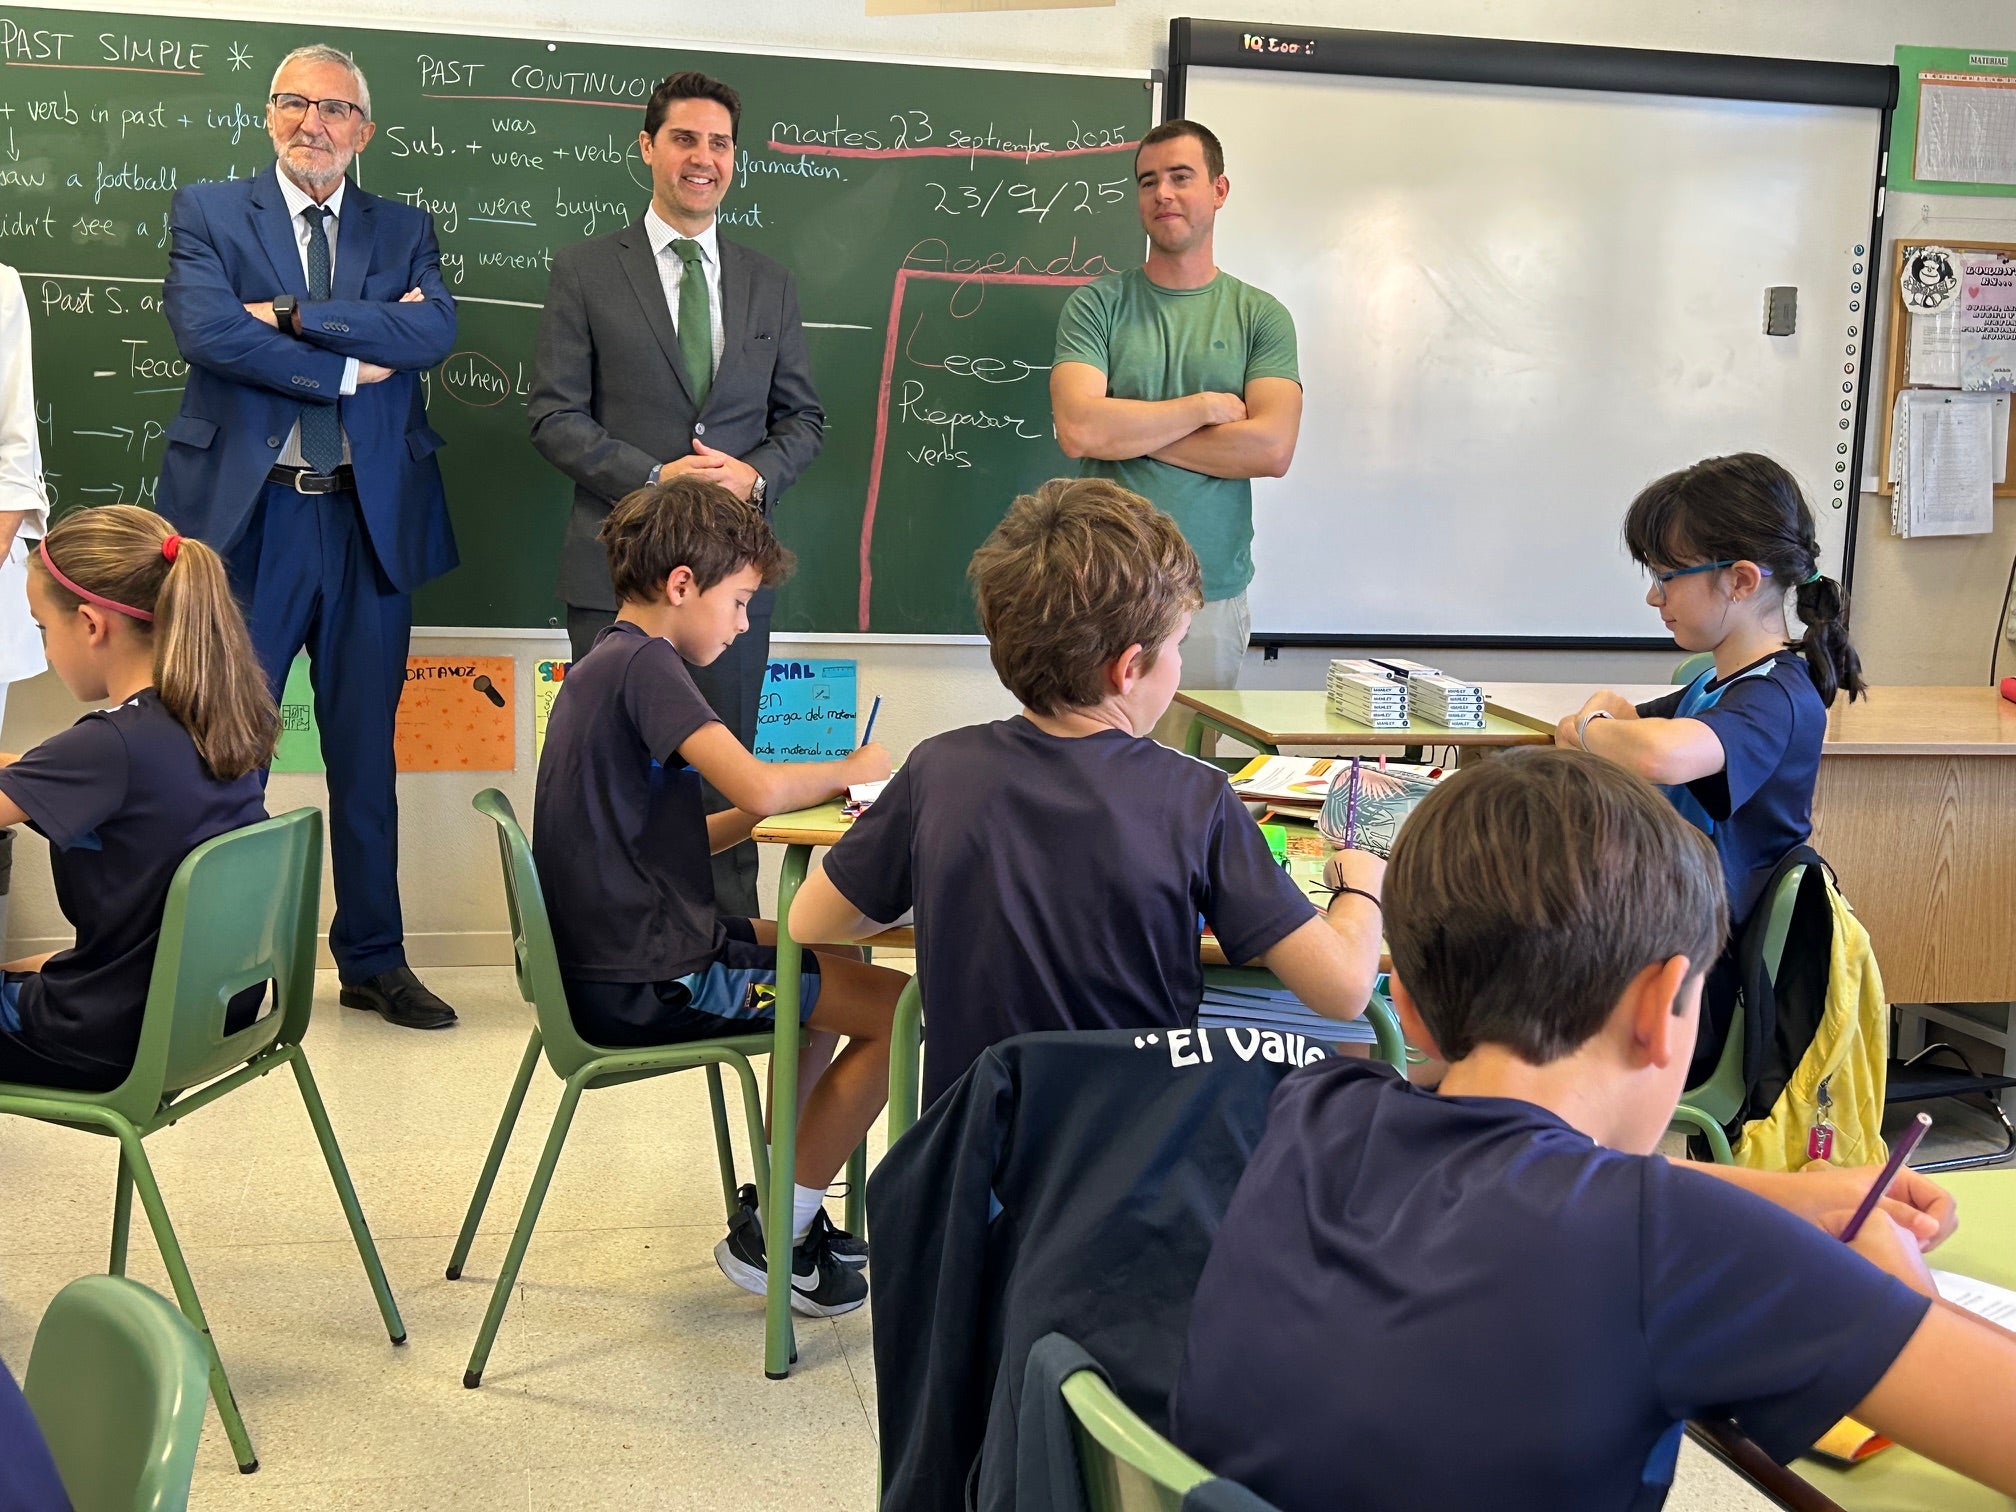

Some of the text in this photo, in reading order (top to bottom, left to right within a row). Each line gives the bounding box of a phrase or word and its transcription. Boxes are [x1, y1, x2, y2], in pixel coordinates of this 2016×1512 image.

[0, 19, 210, 69] PAST SIMPLE
[1970, 56, 2007, 65] MATERIAL
[417, 54, 485, 87] PAST
[28, 90, 79, 124] verb
[91, 104, 109, 122] in
[121, 101, 168, 139] past
[491, 118, 537, 135] was
[386, 126, 456, 157] Sub.
[491, 151, 544, 170] were
[575, 134, 623, 163] verb
[1066, 119, 1126, 151] 2025
[66, 173, 83, 188] a
[95, 161, 177, 204] football
[478, 197, 533, 219] were
[555, 187, 630, 236] buying
[717, 203, 775, 228] hirt.
[925, 178, 1128, 223] 23/9/25
[0, 206, 57, 238] idn't
[73, 216, 116, 236] see
[137, 224, 149, 236] a
[479, 247, 554, 272] weren't
[903, 236, 1120, 318] Agenda
[42, 280, 95, 317] Past
[105, 287, 129, 314] S.
[905, 312, 1055, 384] Leer
[448, 358, 505, 394] when
[899, 380, 1042, 450] Repasar
[906, 433, 972, 468] verbs
[406, 666, 477, 682] ORTAVOZ
[766, 662, 816, 683] RIAL
[758, 711, 802, 726] carga
[805, 706, 824, 721] del
[781, 742, 822, 756] material
[825, 748, 834, 756] a
